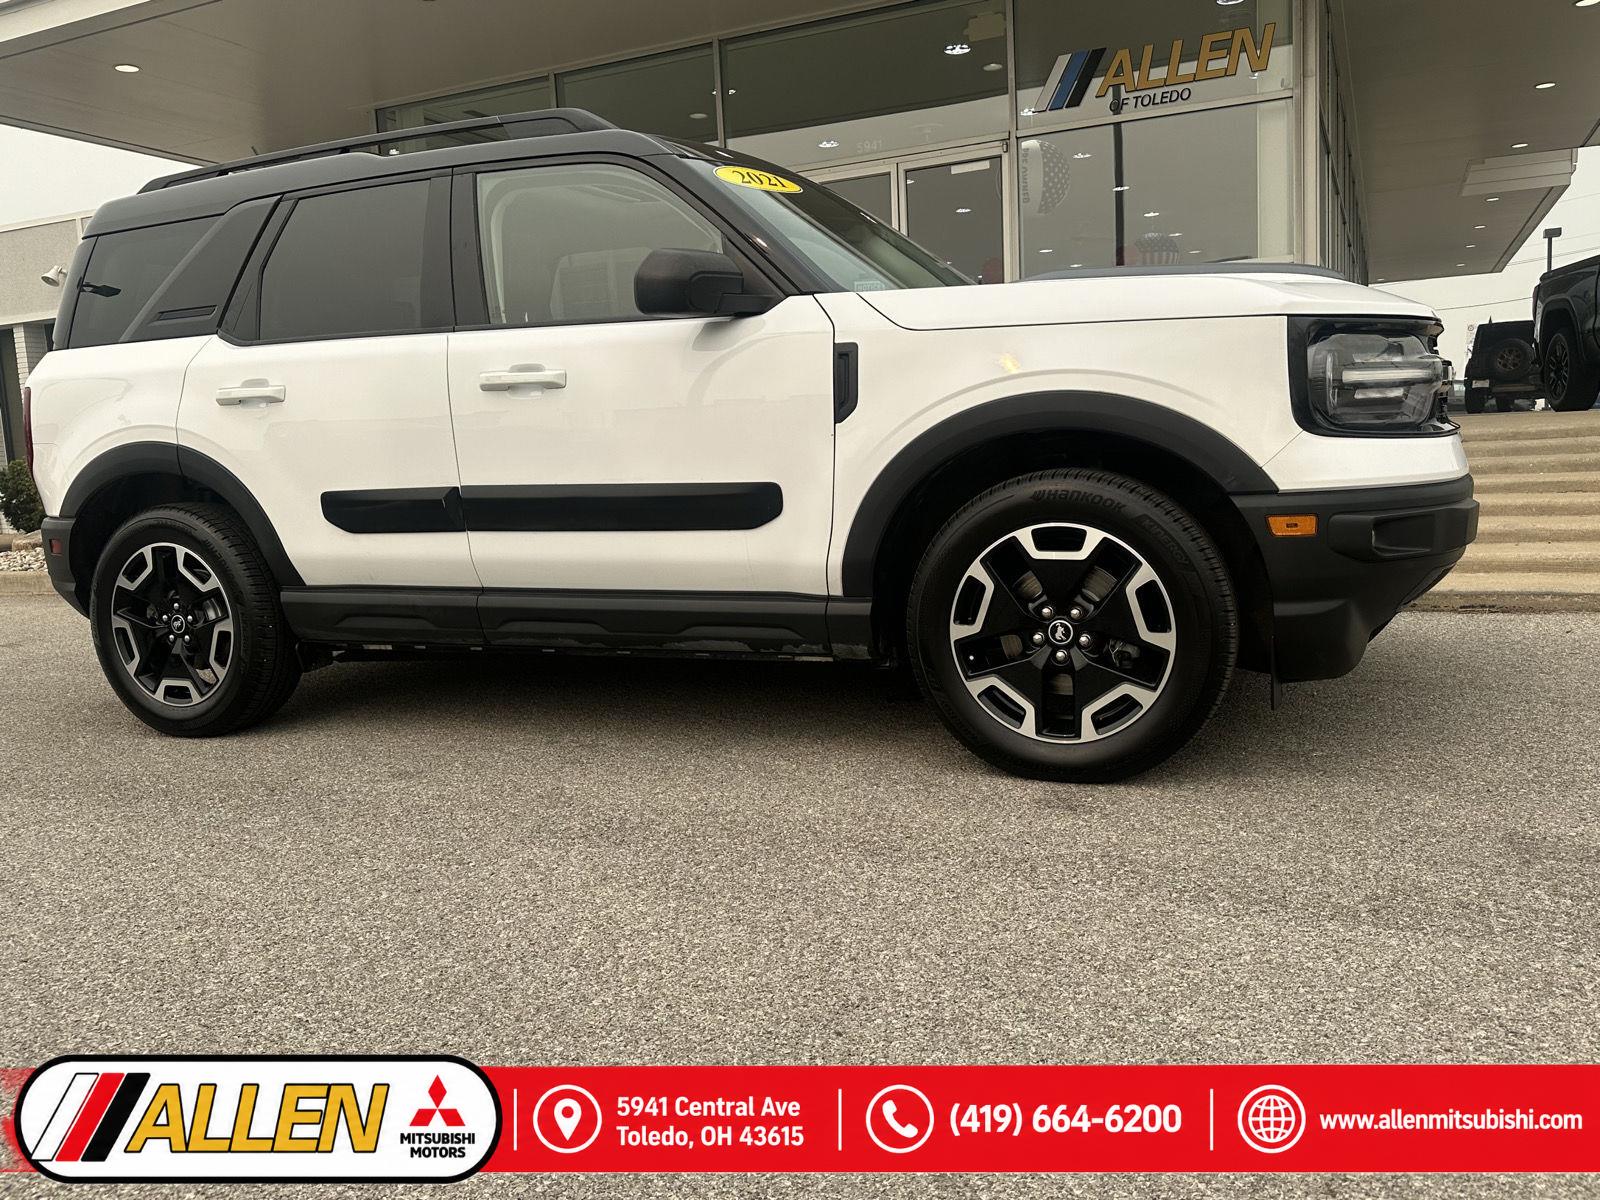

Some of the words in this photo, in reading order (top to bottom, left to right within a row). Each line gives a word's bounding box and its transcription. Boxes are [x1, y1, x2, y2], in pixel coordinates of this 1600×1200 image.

[1095, 23, 1276, 98] ALLEN
[1109, 97, 1130, 112] OF
[1133, 87, 1192, 109] TOLEDO
[856, 139, 882, 154] 5941
[732, 170, 788, 188] 2021
